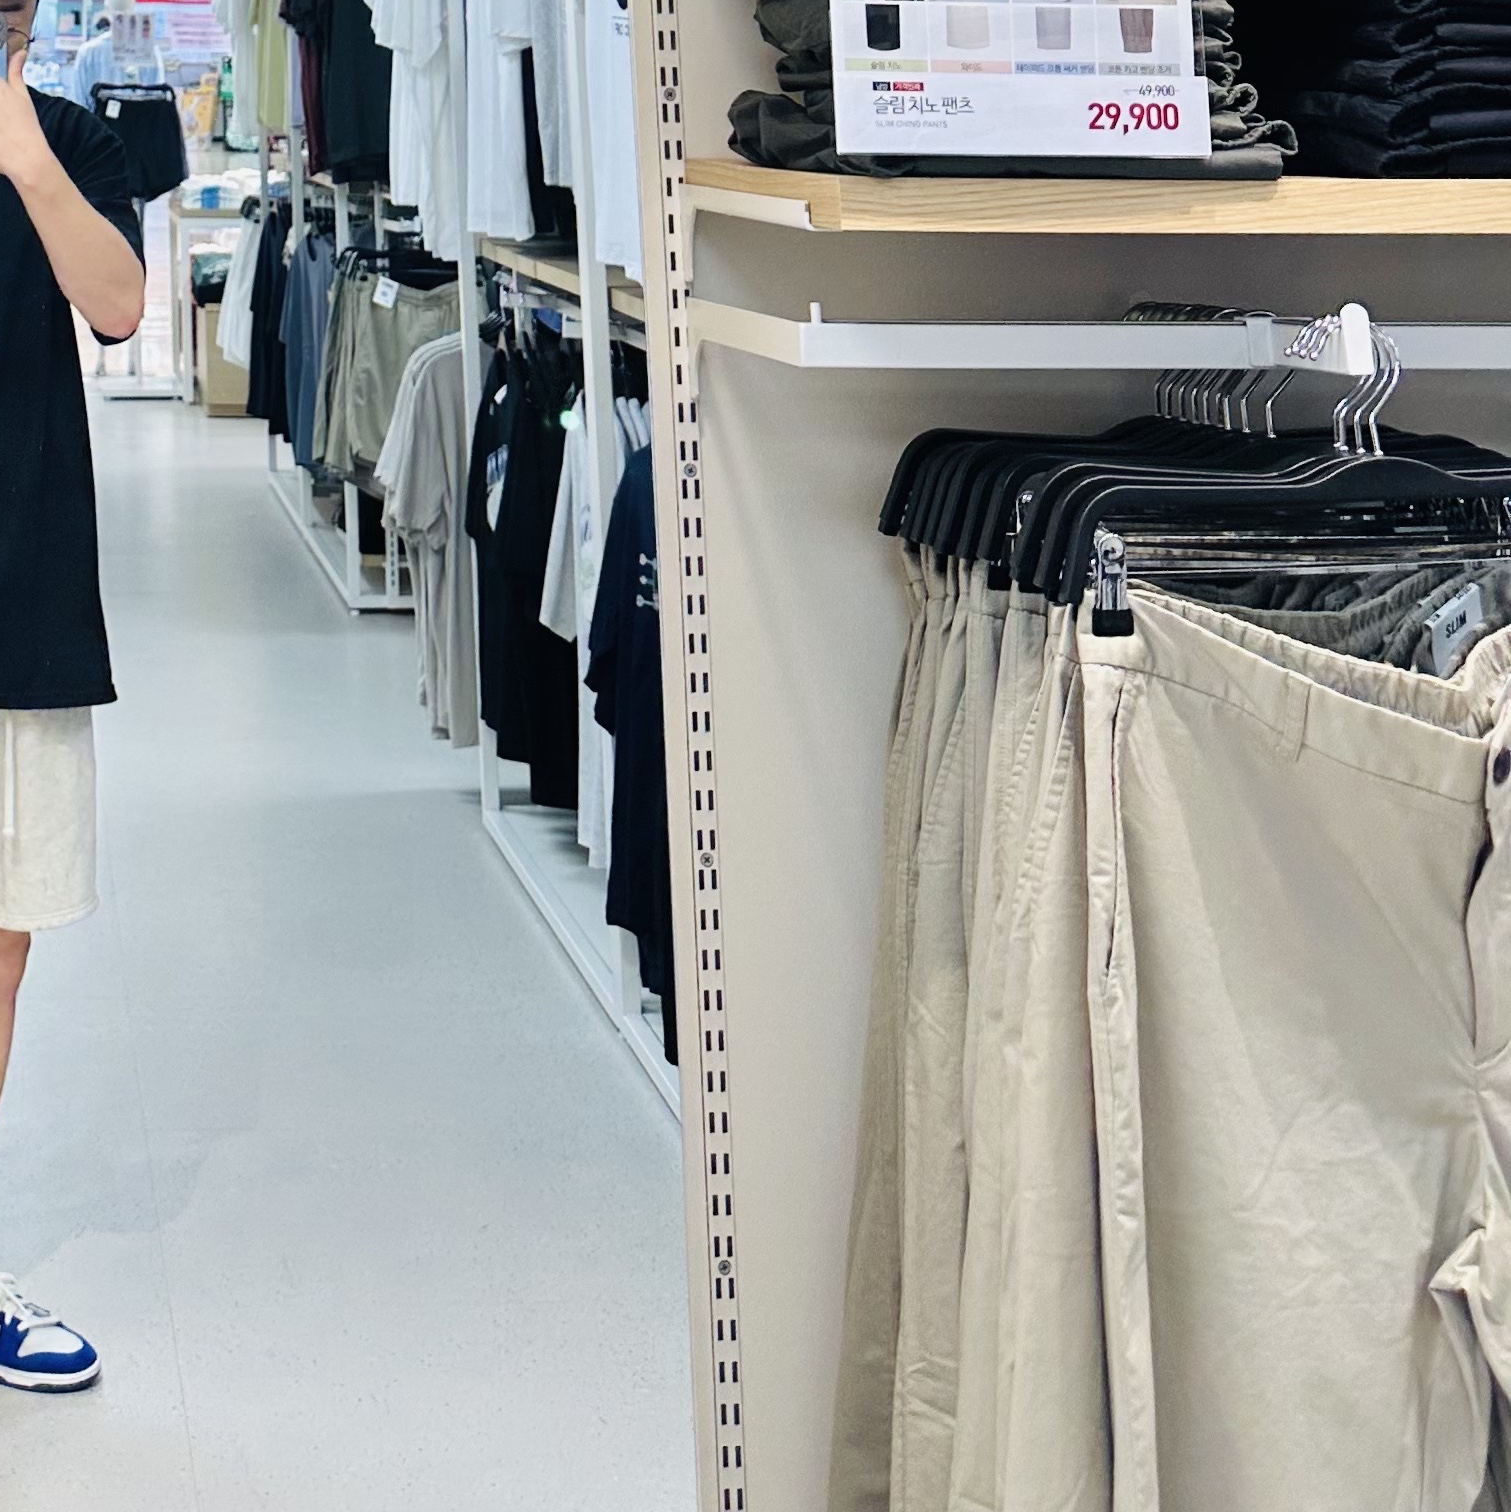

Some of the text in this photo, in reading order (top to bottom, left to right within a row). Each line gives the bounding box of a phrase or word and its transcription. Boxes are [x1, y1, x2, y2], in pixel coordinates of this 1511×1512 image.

[1138, 84, 1176, 98] 49,900
[922, 120, 948, 128] PANTS
[1087, 102, 1179, 135] 29,900
[1445, 609, 1468, 639] SLIM
